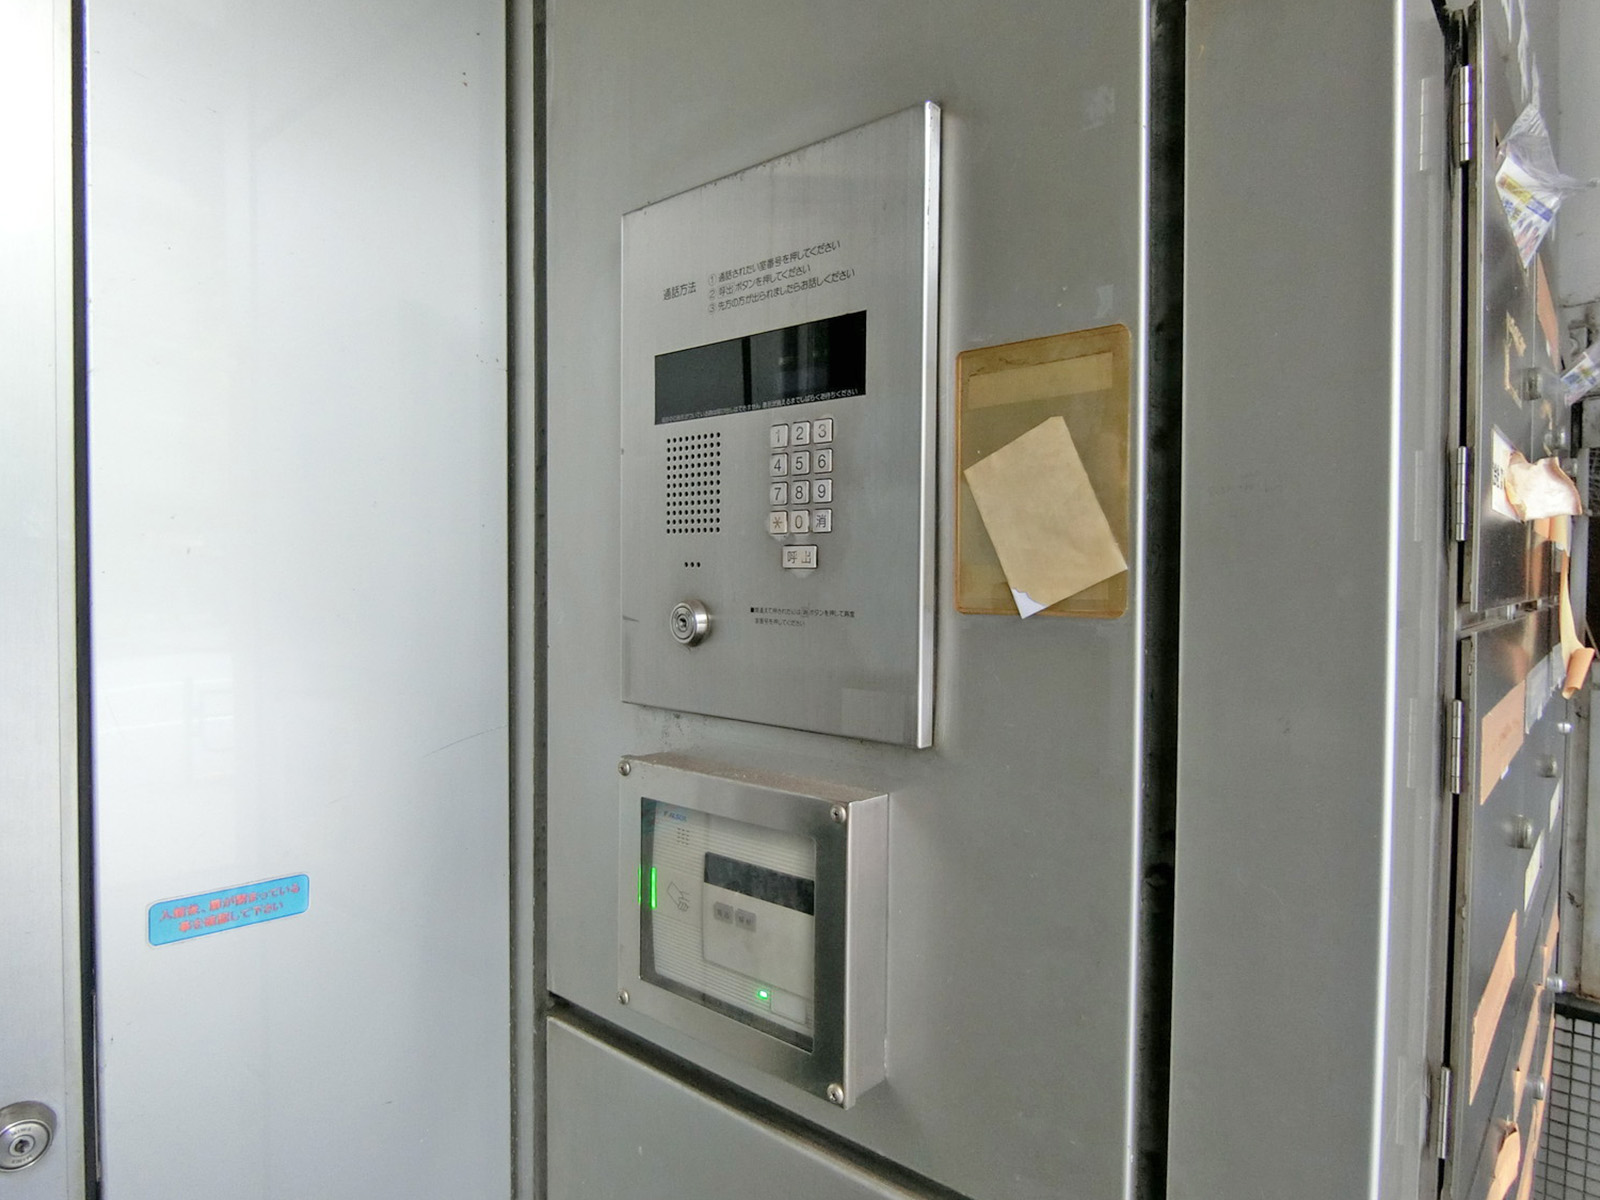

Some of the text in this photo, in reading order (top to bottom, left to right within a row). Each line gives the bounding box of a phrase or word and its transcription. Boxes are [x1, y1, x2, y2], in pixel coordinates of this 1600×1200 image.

[663, 281, 696, 300] 通話方法
[796, 427, 804, 440] 2
[818, 424, 827, 438] 3
[774, 458, 782, 472] 4
[795, 456, 804, 470] 5
[818, 454, 827, 468] 6
[774, 487, 782, 501] 7
[795, 486, 804, 499] 8
[818, 484, 826, 498] 9
[795, 515, 803, 529] 0
[787, 551, 812, 564] 呼出
